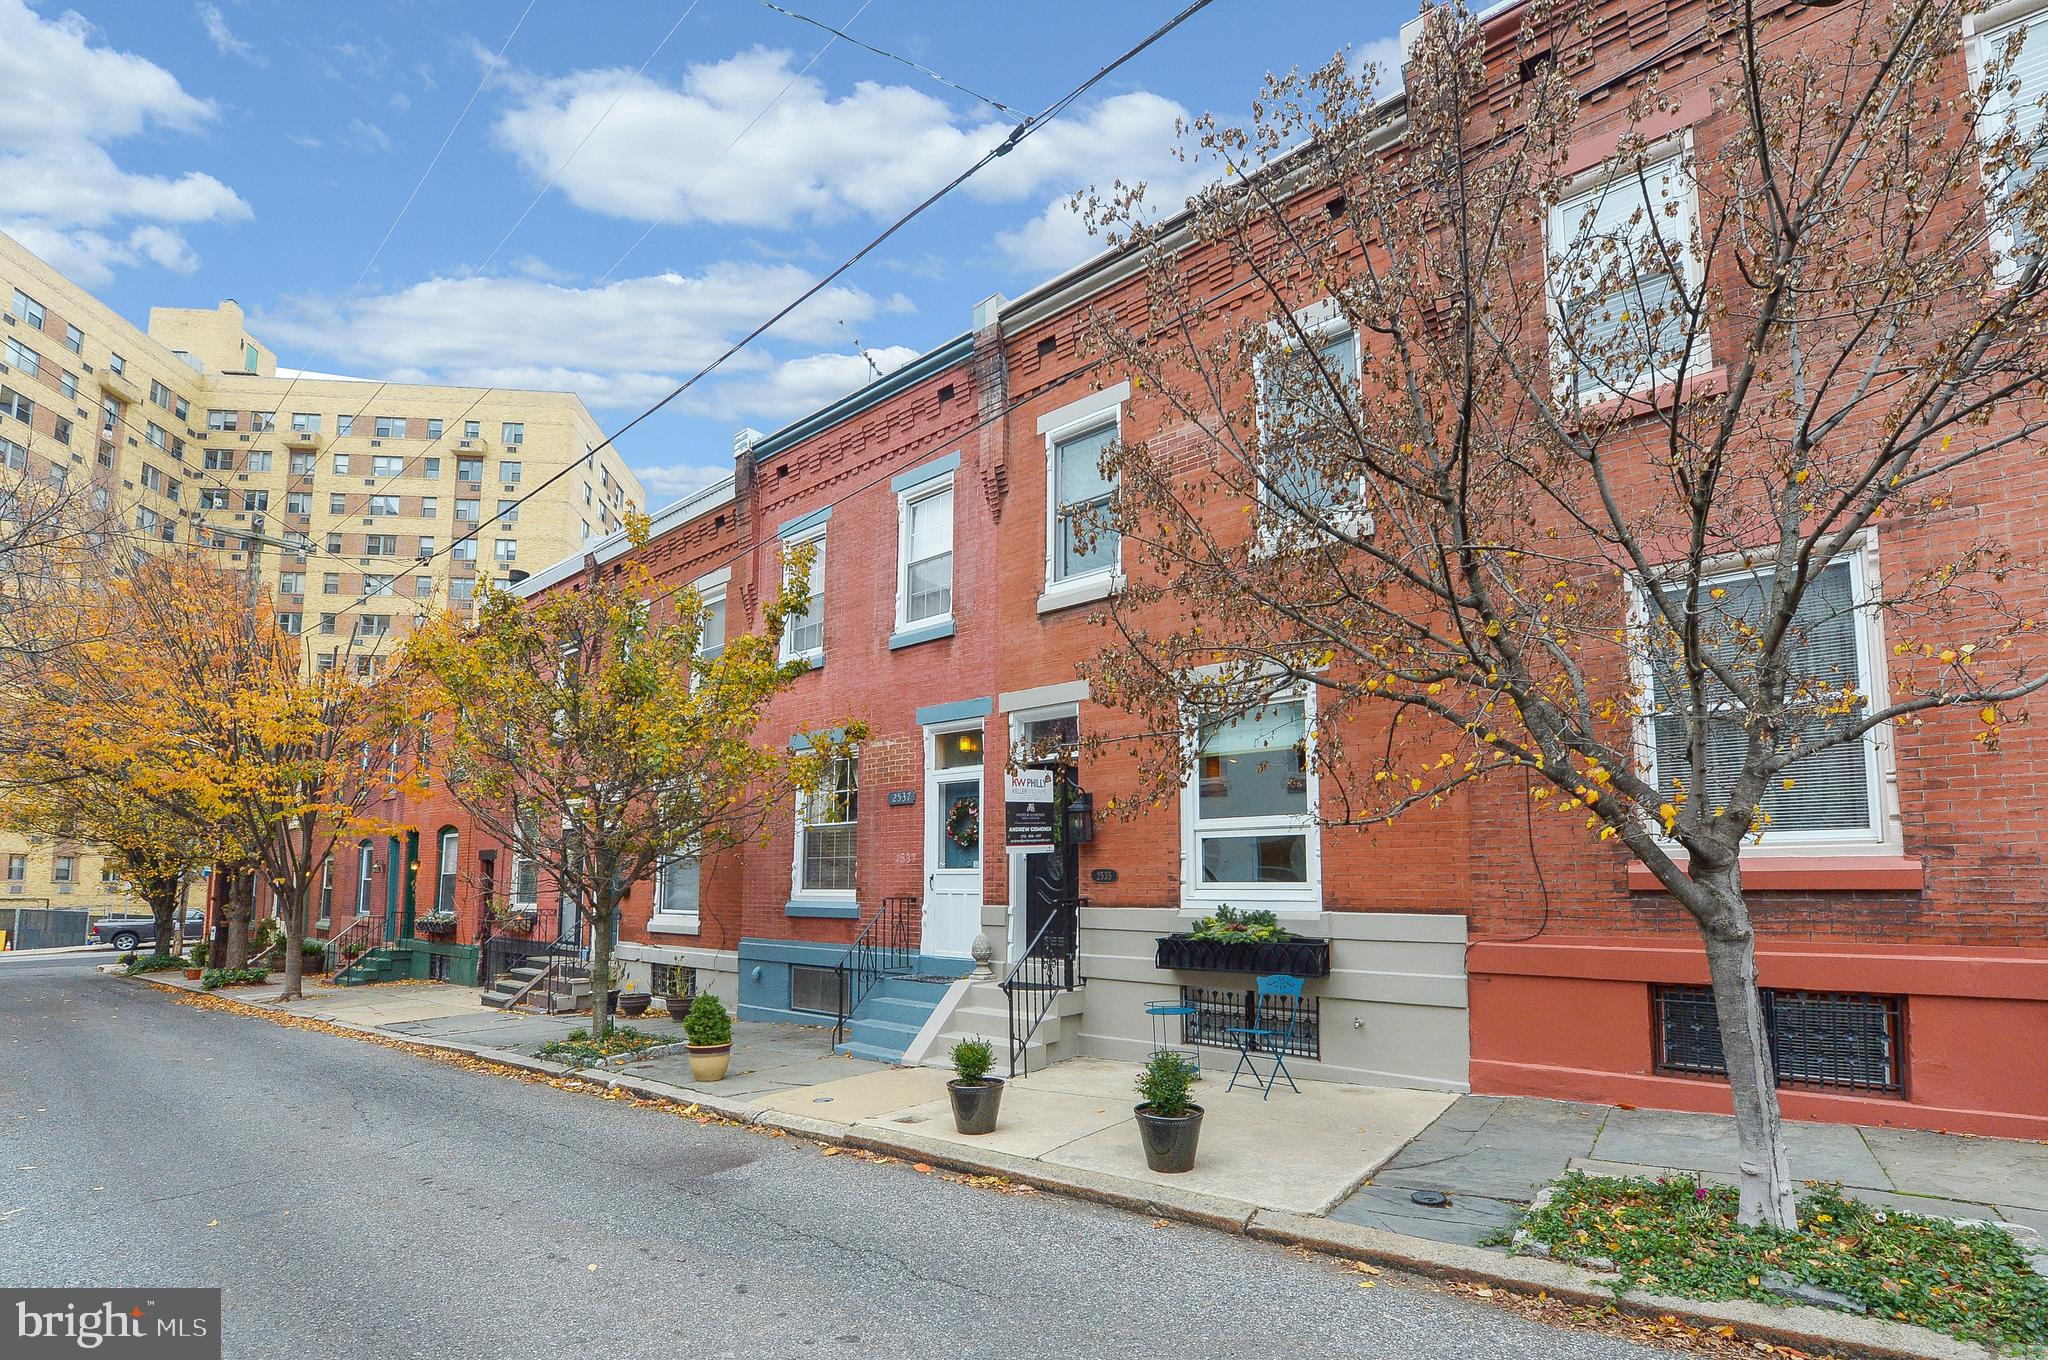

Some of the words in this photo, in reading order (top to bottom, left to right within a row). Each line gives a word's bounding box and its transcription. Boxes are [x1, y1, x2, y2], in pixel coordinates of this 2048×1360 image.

[1012, 778, 1026, 788] KW
[1027, 778, 1047, 788] PHILLY
[892, 792, 911, 803] 2537
[1096, 871, 1112, 881] 2535
